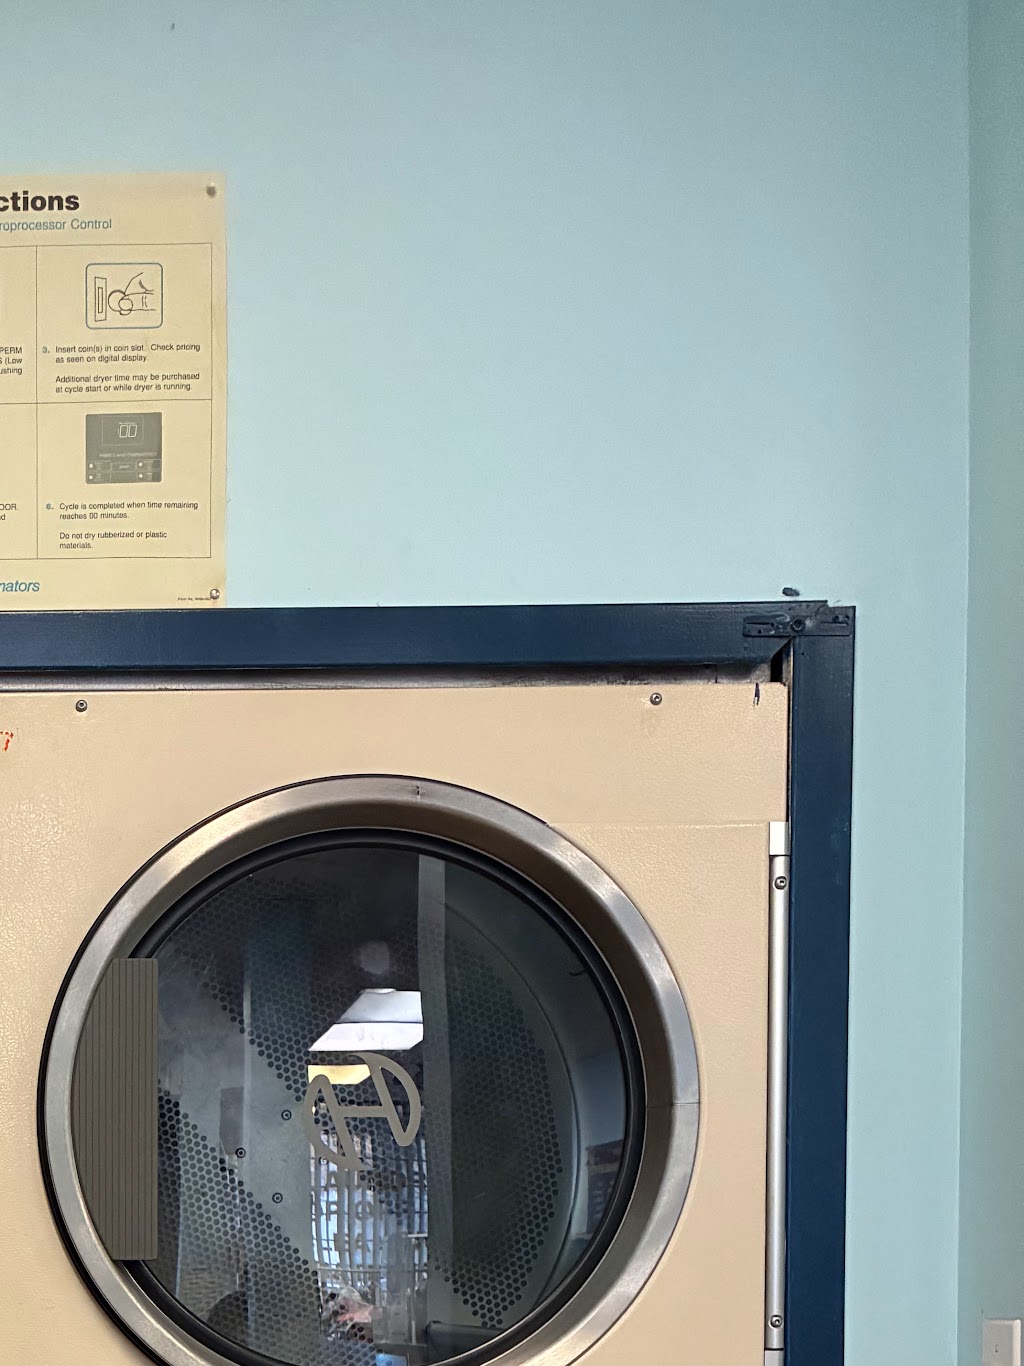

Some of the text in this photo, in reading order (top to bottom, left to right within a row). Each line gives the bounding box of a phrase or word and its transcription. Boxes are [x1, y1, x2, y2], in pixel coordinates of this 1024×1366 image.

[70, 218, 112, 230] Control
[78, 345, 103, 355] coin(s)
[176, 343, 201, 353] pricing
[4, 357, 23, 366] (Low
[98, 355, 120, 364] digital
[56, 375, 91, 383] Additional
[93, 374, 112, 384] dryer
[132, 375, 148, 383] may
[150, 373, 159, 381] be
[161, 372, 200, 382] purchased
[64, 385, 83, 395] cycle
[113, 384, 132, 392] while
[134, 384, 152, 393] dryer
[155, 383, 161, 391] is
[59, 502, 79, 512] Cycle
[81, 502, 87, 510] is
[88, 502, 125, 512] completed
[164, 501, 199, 511] remaining
[100, 511, 129, 519] minutes.
[84, 532, 96, 541] dry
[97, 531, 134, 539] rubberized
[145, 531, 167, 540] plastic
